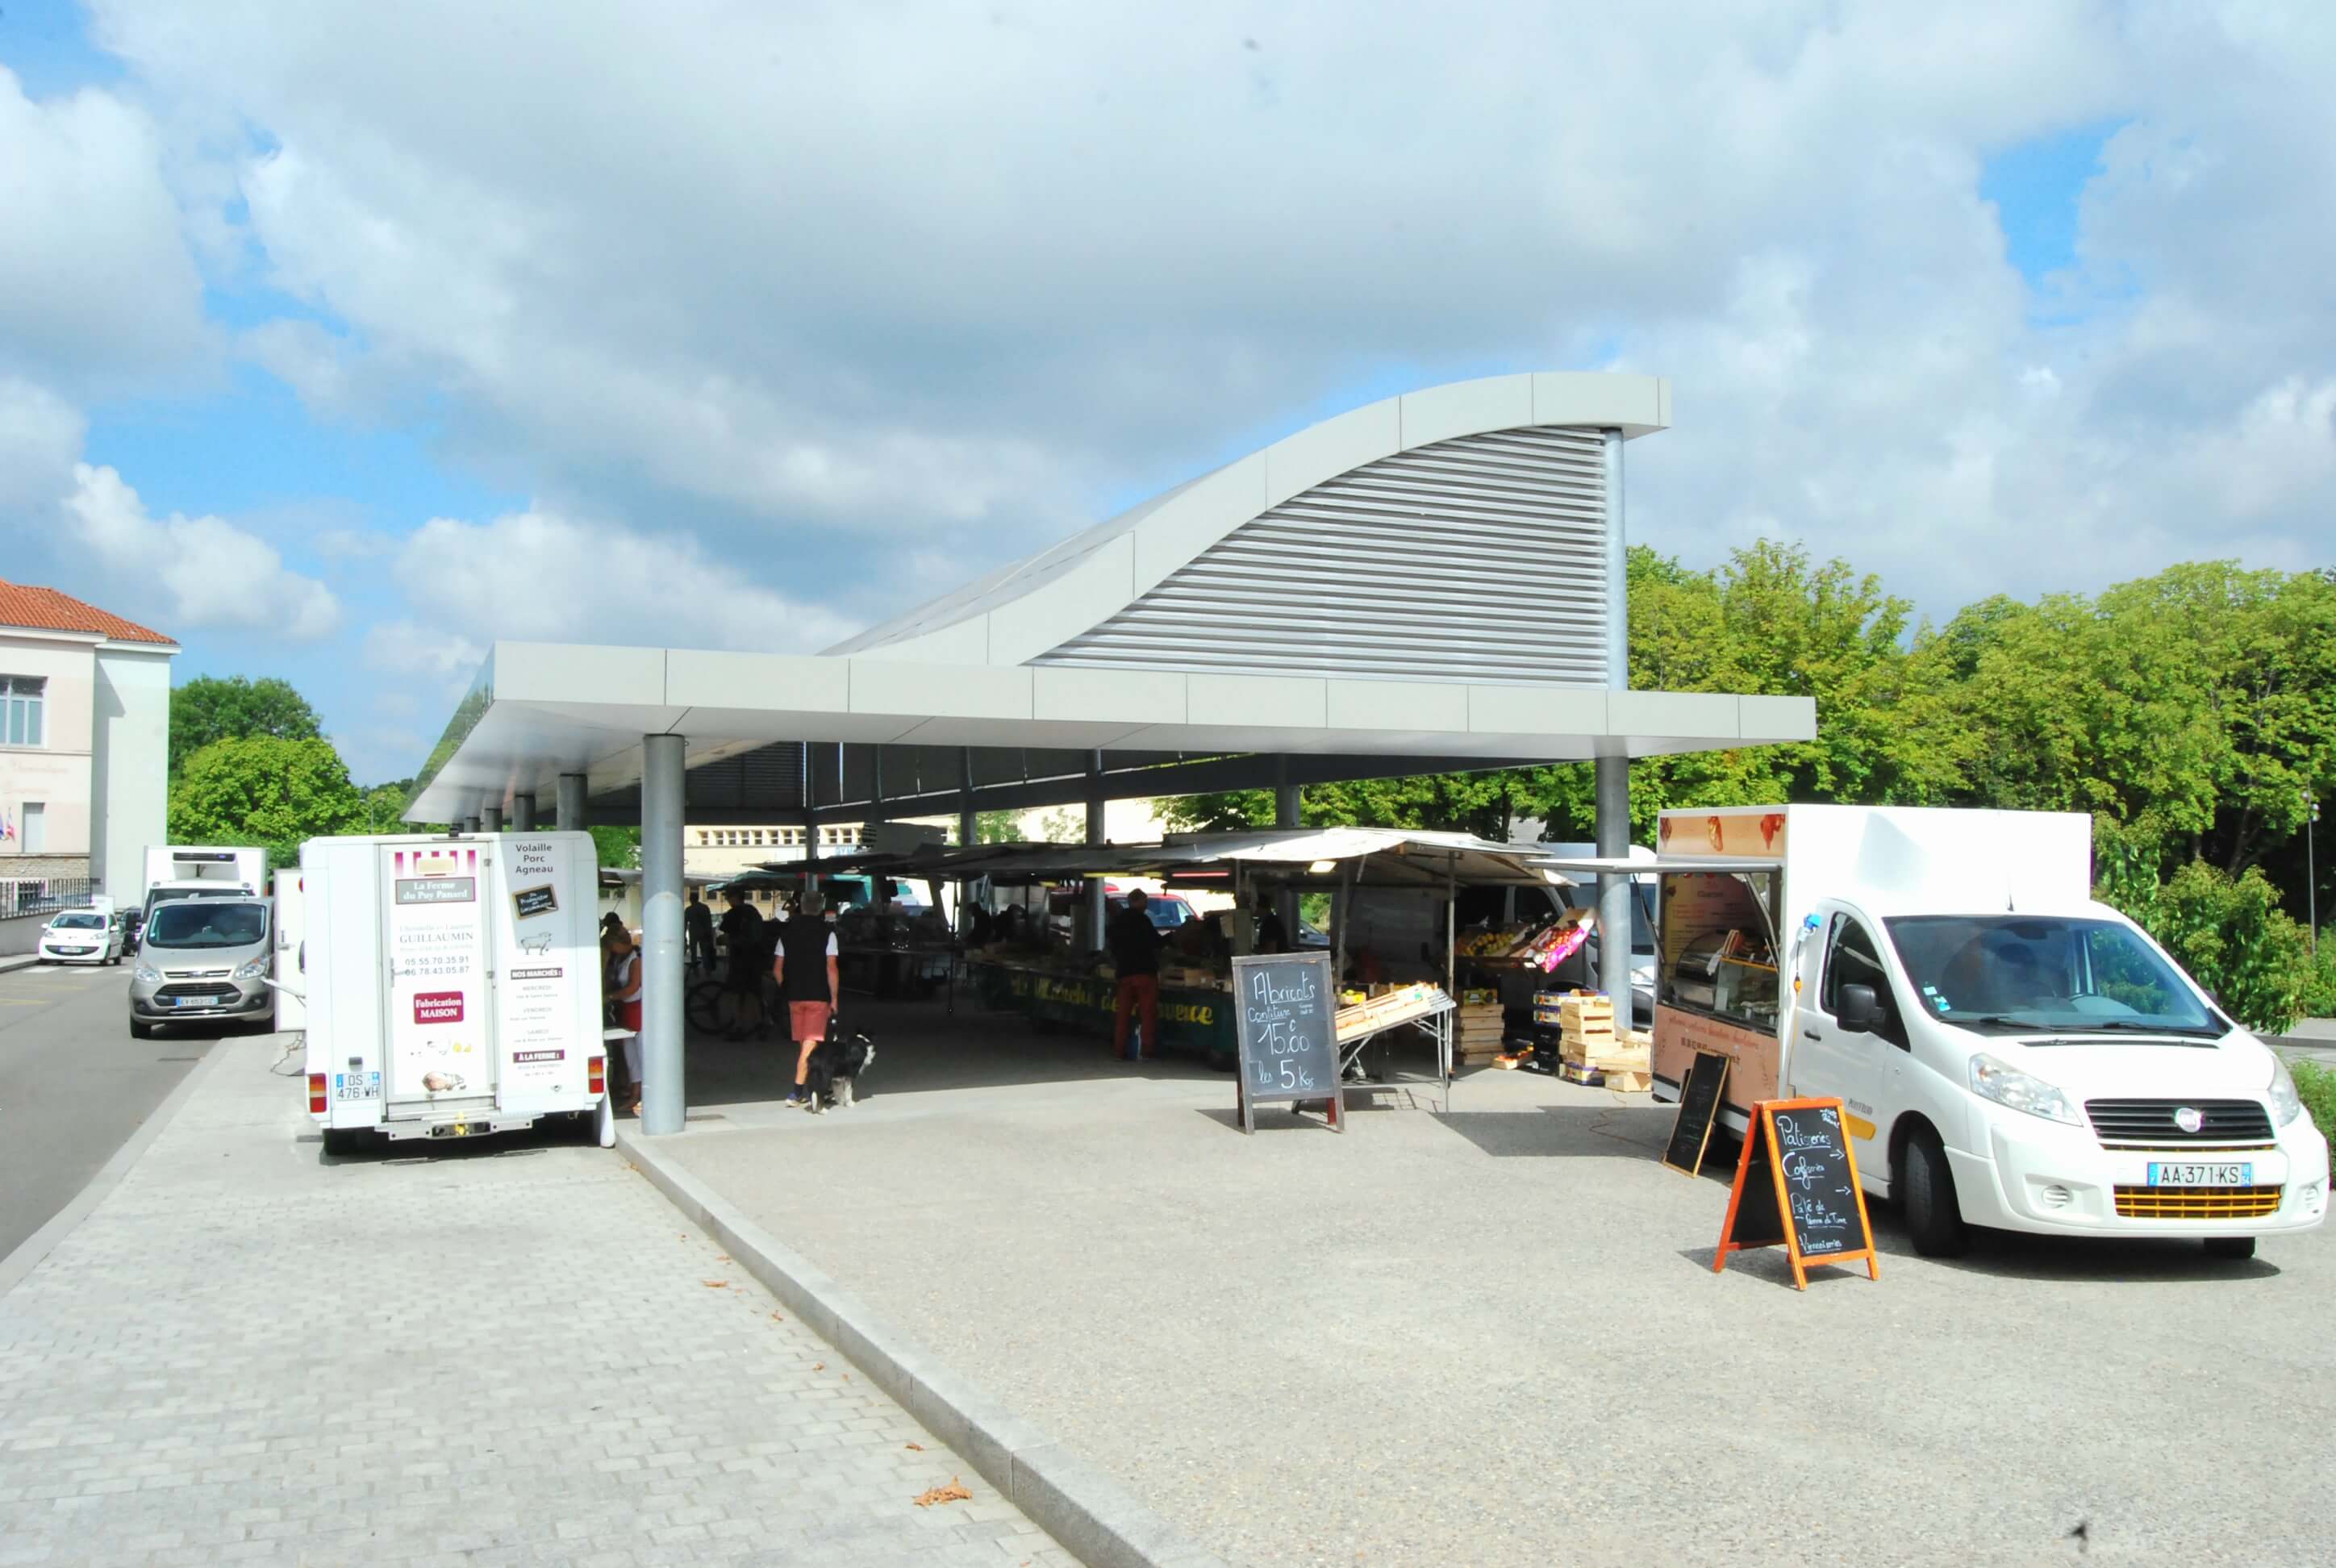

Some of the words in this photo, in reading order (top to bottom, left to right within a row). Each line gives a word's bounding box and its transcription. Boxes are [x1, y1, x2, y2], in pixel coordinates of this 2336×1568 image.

[516, 844, 553, 852] Volaille
[524, 854, 545, 862] Porc
[516, 865, 553, 875] Agneau
[414, 882, 424, 890] La
[427, 881, 456, 890] Ferme
[403, 891, 416, 900] du
[399, 932, 474, 943] GUILLAUMIN
[1254, 971, 1315, 1005] Abricots
[415, 998, 461, 1007] Fabrication
[421, 1008, 457, 1018] MAISON
[1280, 1058, 1296, 1089] 5
[2161, 1166, 2239, 1183] AA-371-KS
